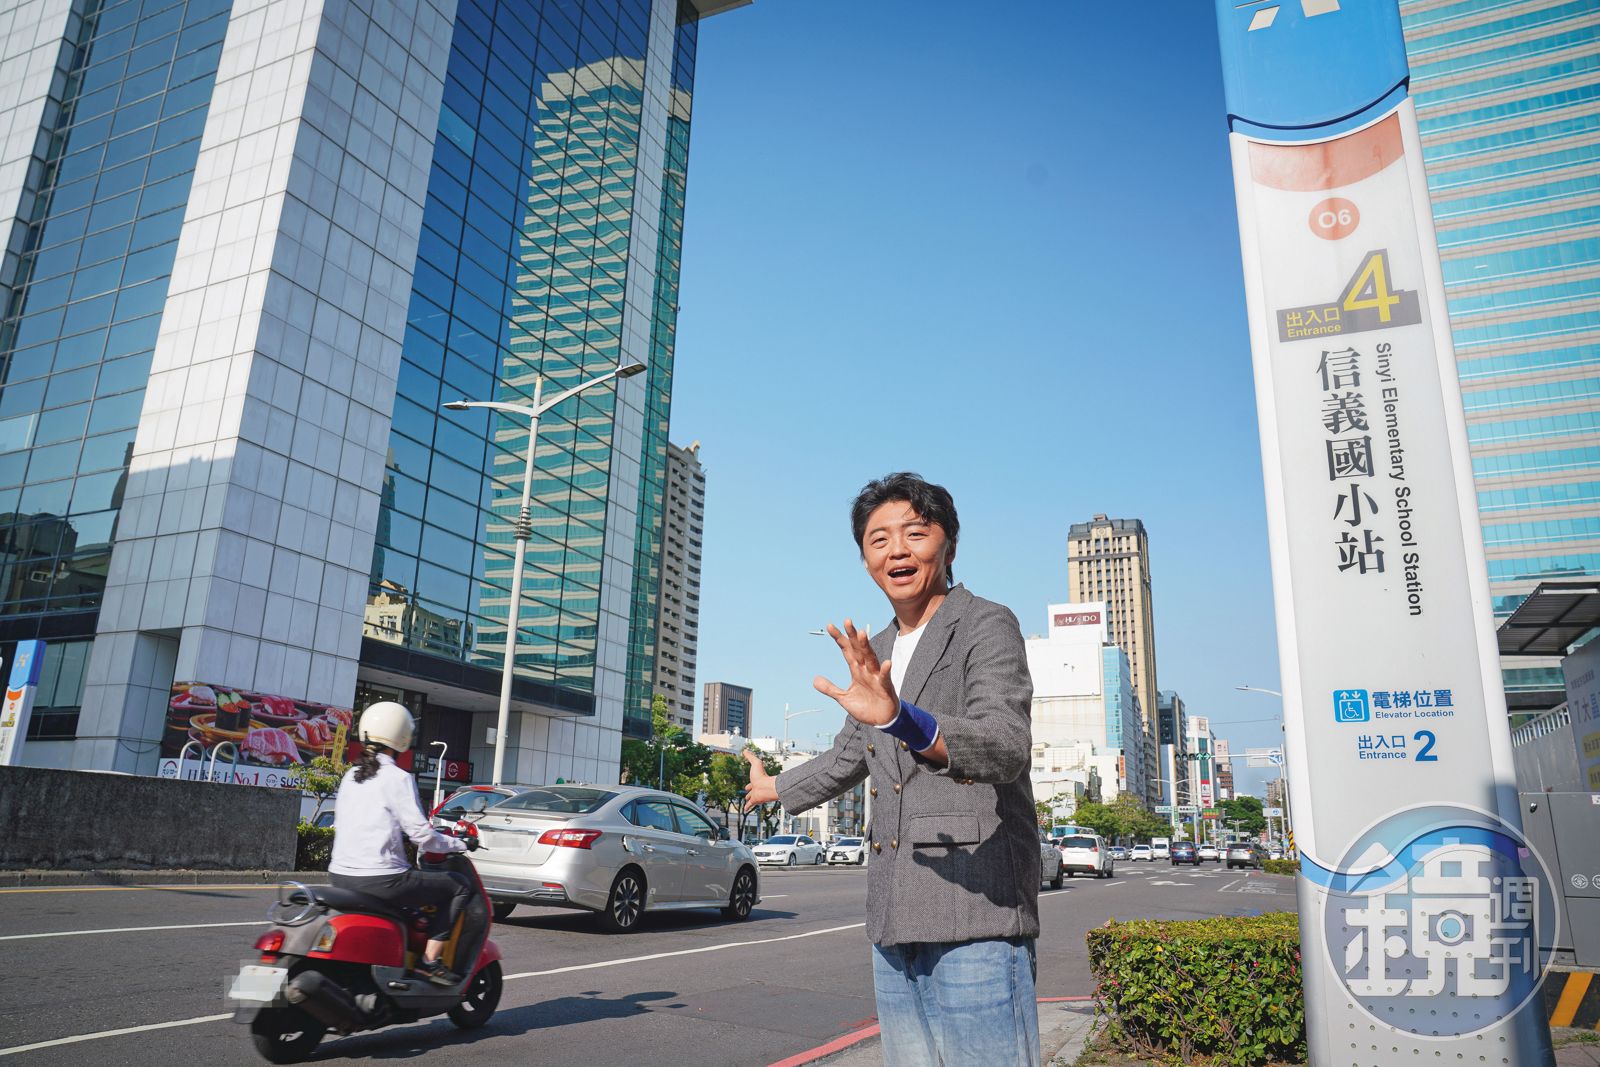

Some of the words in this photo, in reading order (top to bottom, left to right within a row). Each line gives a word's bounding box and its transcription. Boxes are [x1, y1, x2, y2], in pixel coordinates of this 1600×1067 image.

[1317, 208, 1352, 229] O6
[1343, 253, 1401, 323] 4
[1286, 307, 1341, 328] 出入口
[1287, 323, 1342, 338] Entrance
[1375, 342, 1396, 383] Sinyi
[1381, 387, 1405, 481] Elementary
[1315, 346, 1386, 575] 信義國小站
[1394, 486, 1417, 547] School
[1403, 552, 1423, 616] Station
[1372, 689, 1454, 709] 電梯位置
[1375, 710, 1412, 719] Elevator
[1414, 710, 1454, 718] Location
[1358, 735, 1406, 749] 出入口
[1359, 751, 1407, 759] Entrance
[1413, 730, 1438, 762] 2
